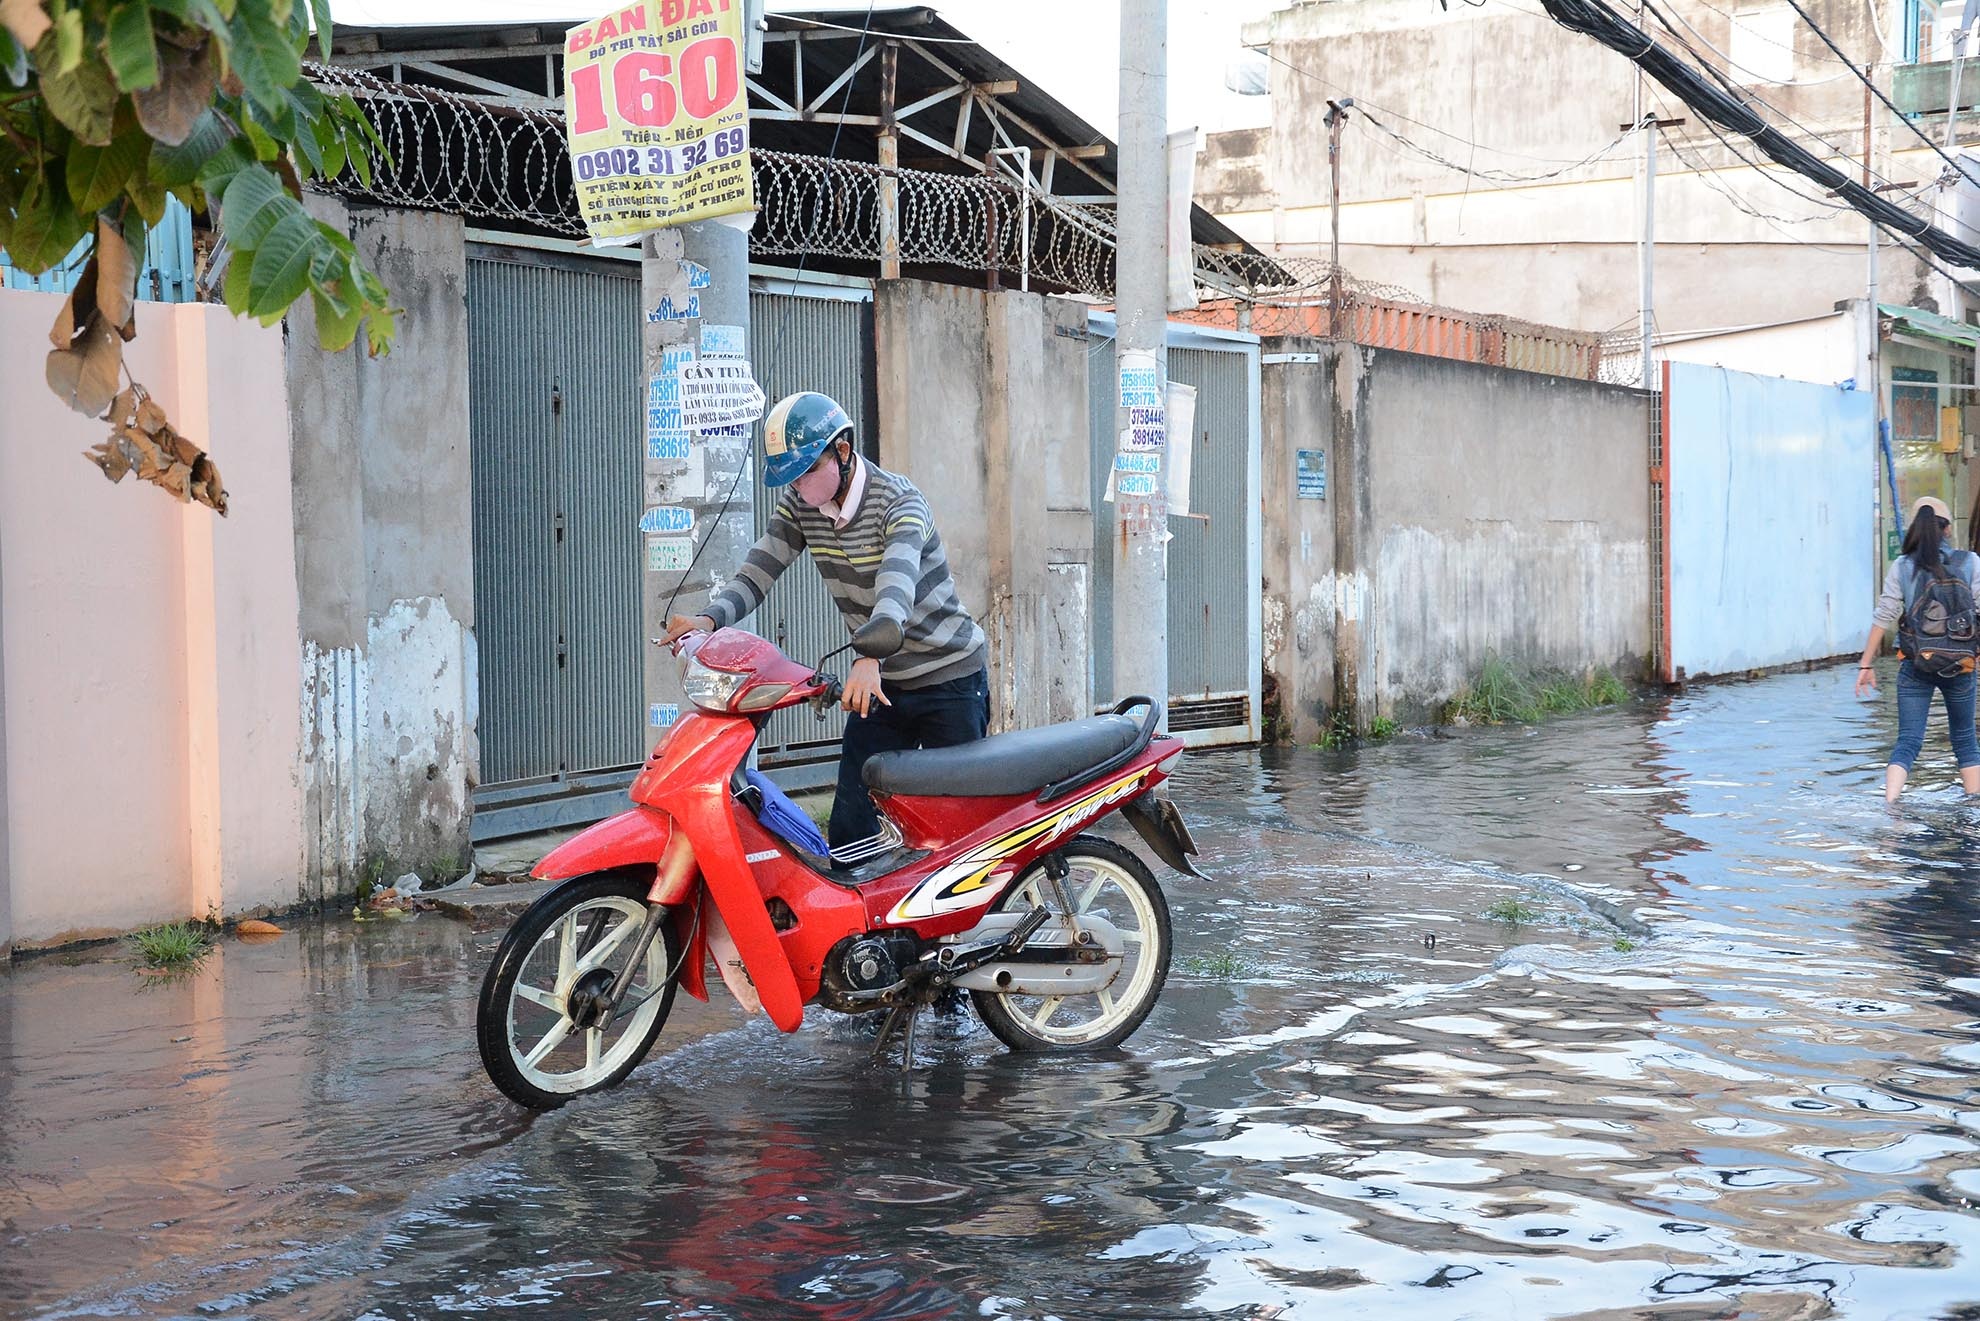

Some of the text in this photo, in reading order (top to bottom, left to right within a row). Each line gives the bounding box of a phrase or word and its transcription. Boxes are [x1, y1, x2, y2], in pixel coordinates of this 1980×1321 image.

[610, 38, 634, 50] THỊ
[667, 25, 688, 43] SÀI
[691, 19, 718, 36] GÒN
[571, 37, 738, 135] 160
[717, 112, 744, 125] NVB
[622, 130, 660, 145] Triệu
[675, 125, 703, 141] Nền
[577, 127, 744, 181] 0902 31 32 69
[585, 180, 630, 194] TIỆN
[633, 178, 666, 191] XÂY
[707, 159, 742, 175] TRỌ
[717, 173, 744, 188] 100%
[590, 212, 613, 223] HẠ
[699, 188, 745, 206] THIỆN
[684, 362, 714, 379] CẦN
[1121, 372, 1155, 387] 37581613
[1121, 391, 1156, 406] 37581774
[698, 411, 717, 424] 0933
[649, 437, 690, 458] 37581613
